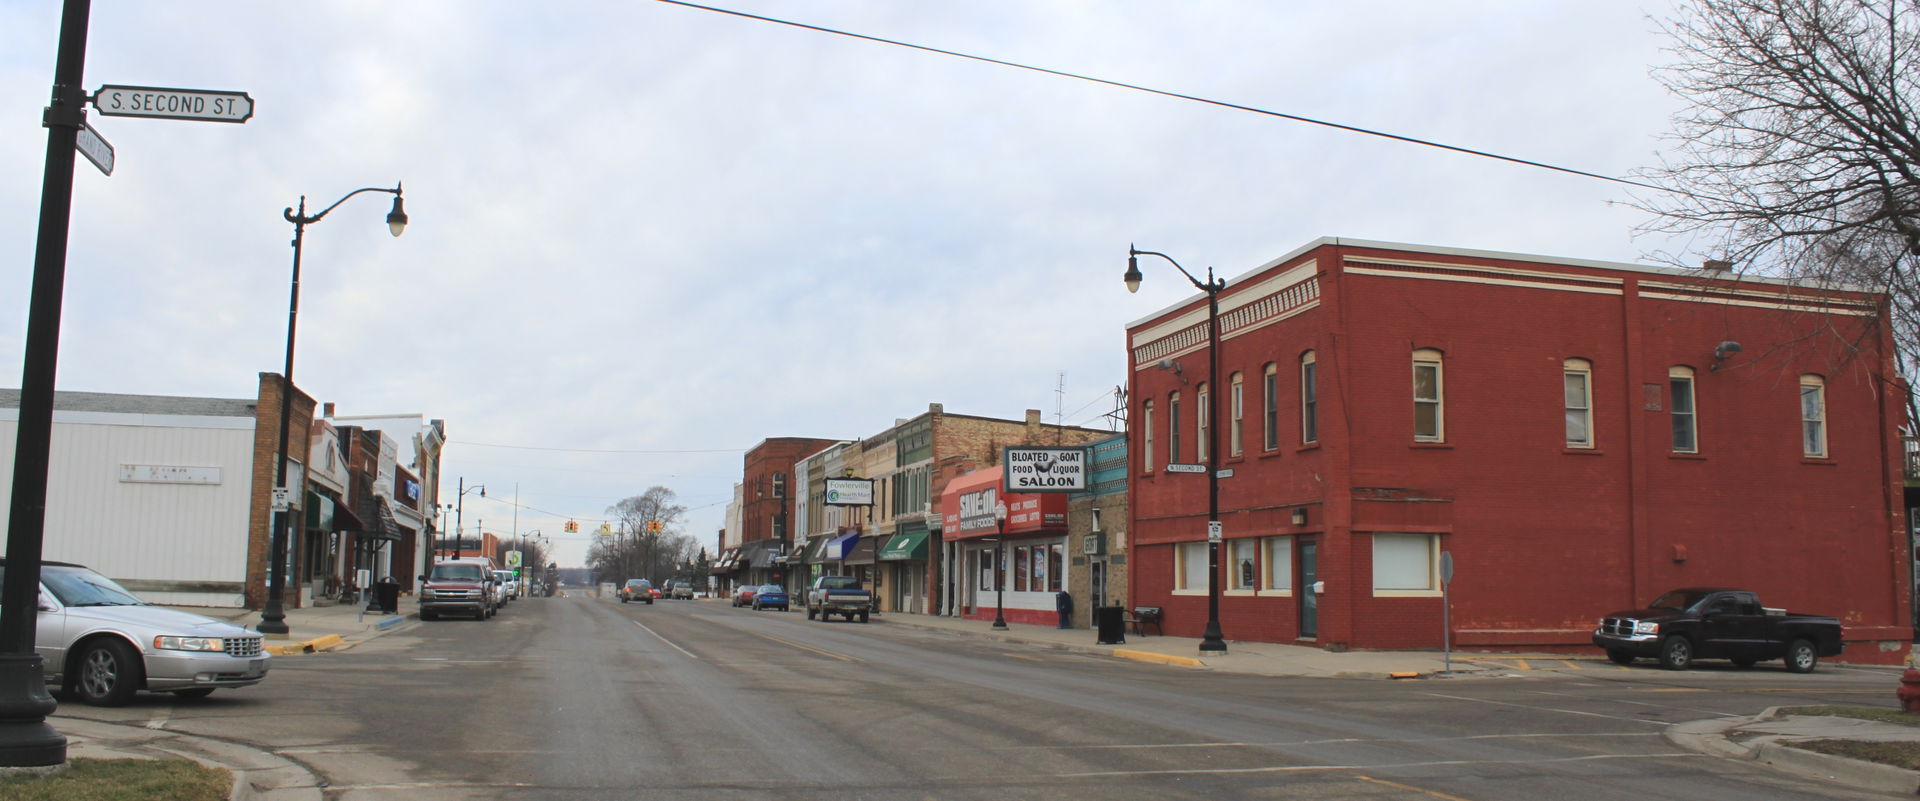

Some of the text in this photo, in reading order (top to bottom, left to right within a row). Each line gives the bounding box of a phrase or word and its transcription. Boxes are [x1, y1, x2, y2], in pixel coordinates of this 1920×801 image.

[111, 92, 236, 116] S. SECOND ST.
[1011, 452, 1080, 462] BLOATED GOAT
[1012, 465, 1080, 474] FOOD LIQUOR
[830, 481, 870, 489] Fowlerville
[1019, 477, 1075, 486] SALOON
[960, 519, 977, 531] FAMILY
[977, 516, 995, 528] FOODS
